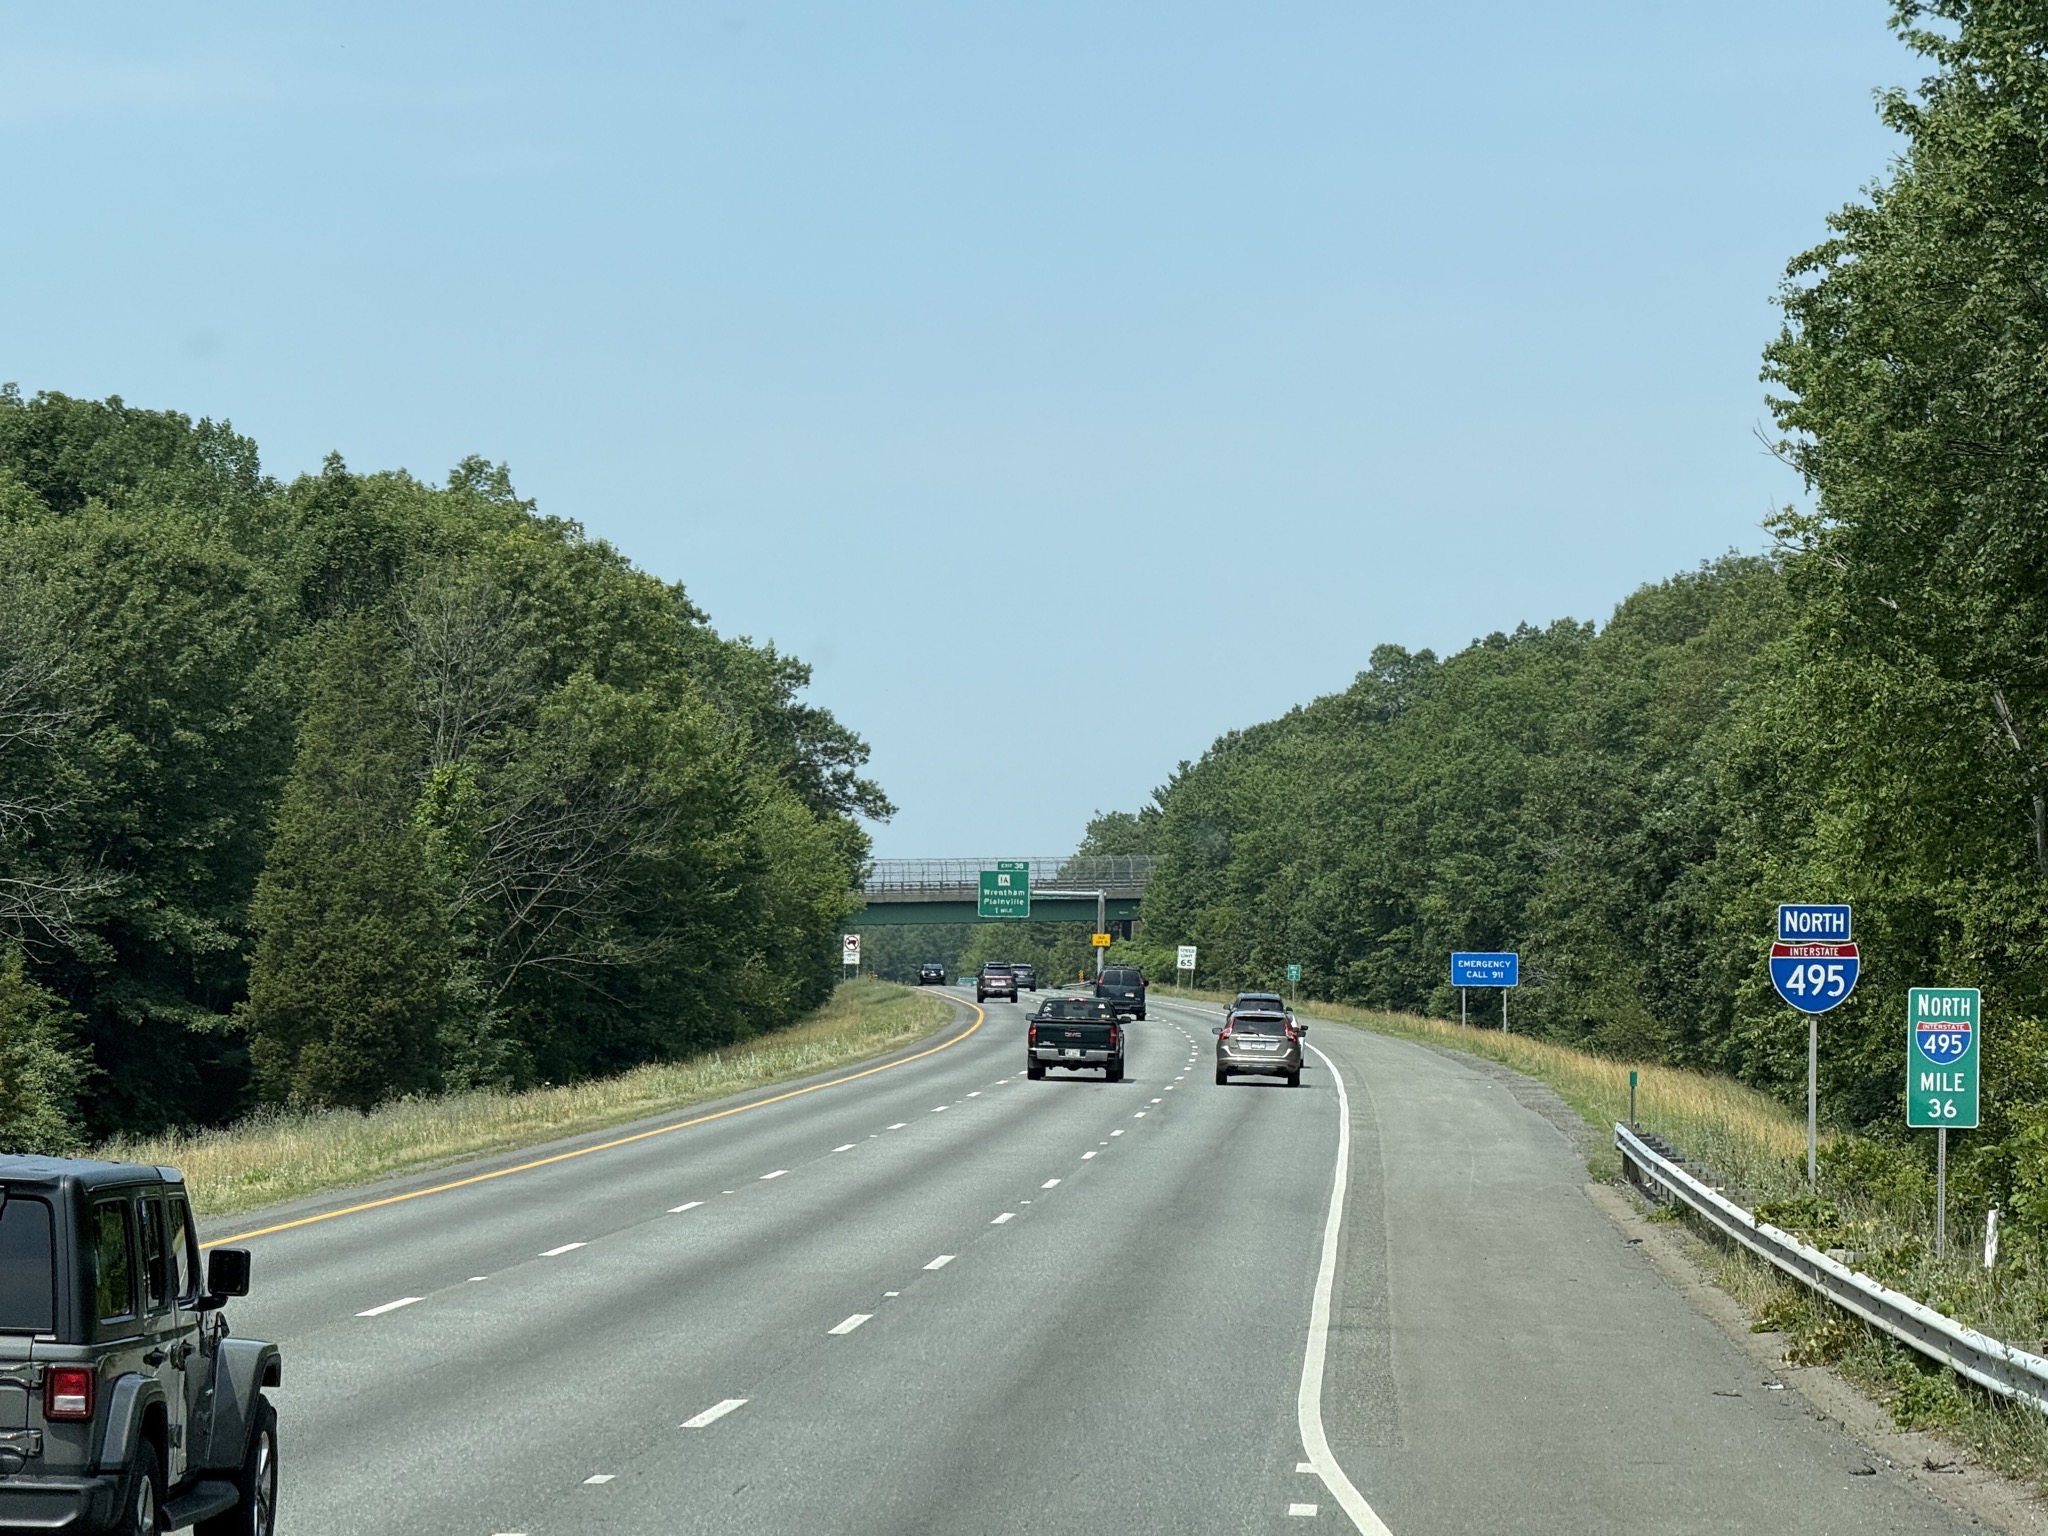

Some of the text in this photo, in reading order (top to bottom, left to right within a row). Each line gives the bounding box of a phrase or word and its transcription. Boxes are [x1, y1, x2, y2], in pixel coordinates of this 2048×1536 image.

[1785, 910, 1845, 933] NORTH
[1789, 947, 1840, 957] INTERSTATE
[1458, 960, 1511, 968] EMERGENCY
[1466, 971, 1504, 979] CALL 911
[1785, 964, 1845, 997] 495
[1918, 994, 1971, 1017] NORTH
[1923, 1034, 1963, 1055] 495
[1920, 1072, 1966, 1092] MILE
[1927, 1098, 1957, 1118] 36
